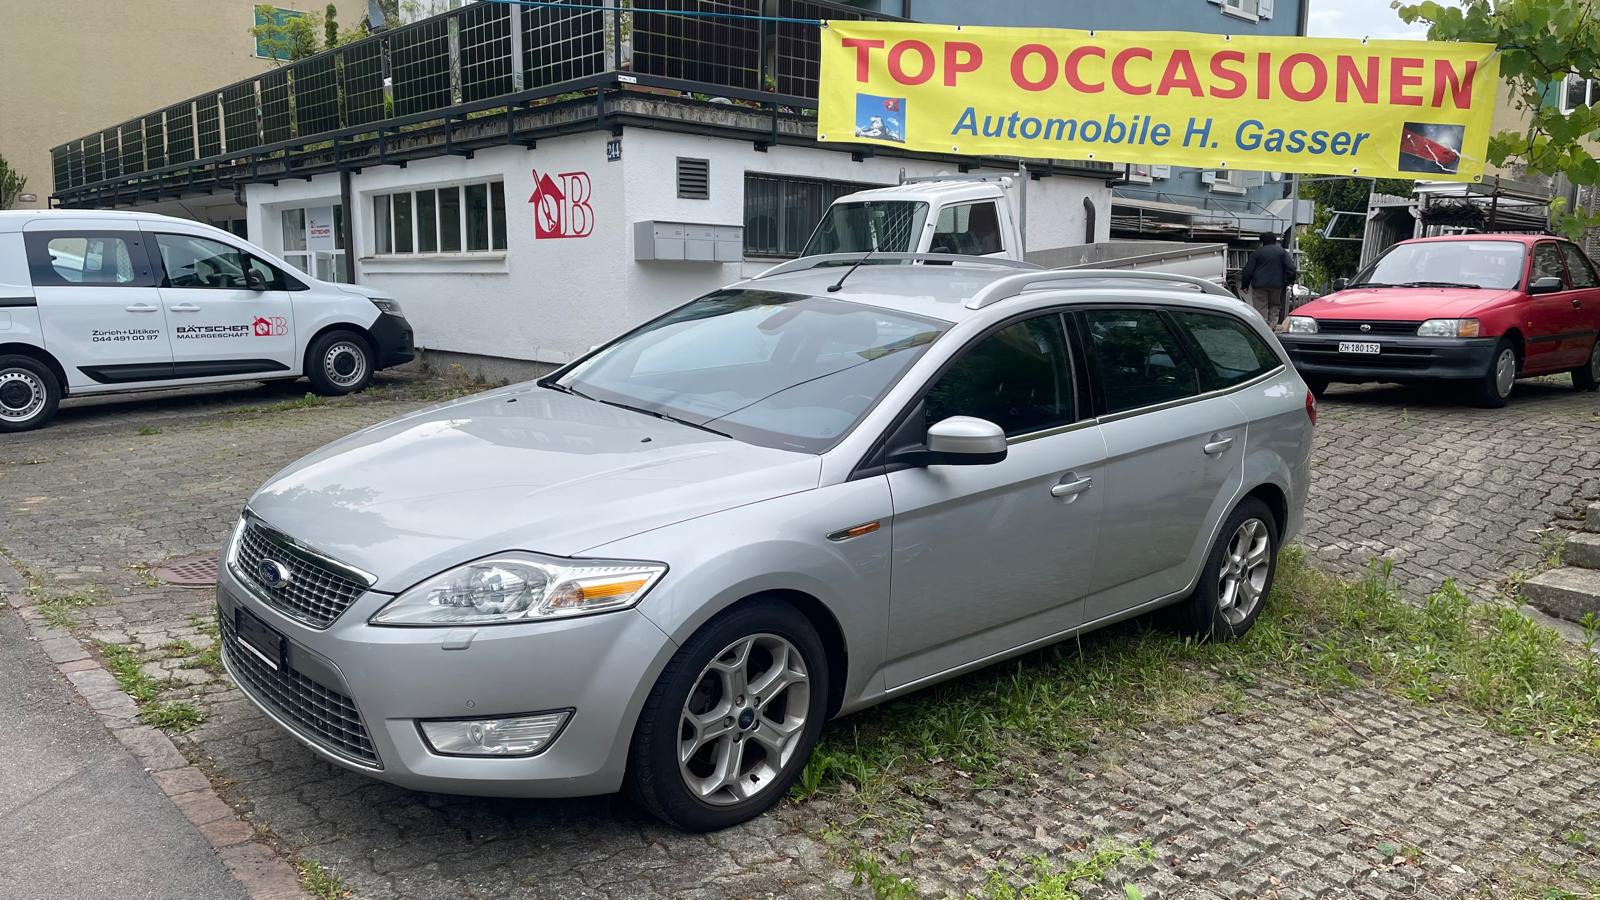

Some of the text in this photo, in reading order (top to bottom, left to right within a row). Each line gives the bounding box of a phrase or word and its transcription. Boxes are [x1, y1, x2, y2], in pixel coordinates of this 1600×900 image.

[842, 37, 1478, 109] TOP OCCASIONEN
[951, 107, 1370, 156] Automobile H. Gasser
[608, 143, 619, 158] 244
[176, 325, 250, 333] BÄTSCHER
[1366, 344, 1379, 353] 152
